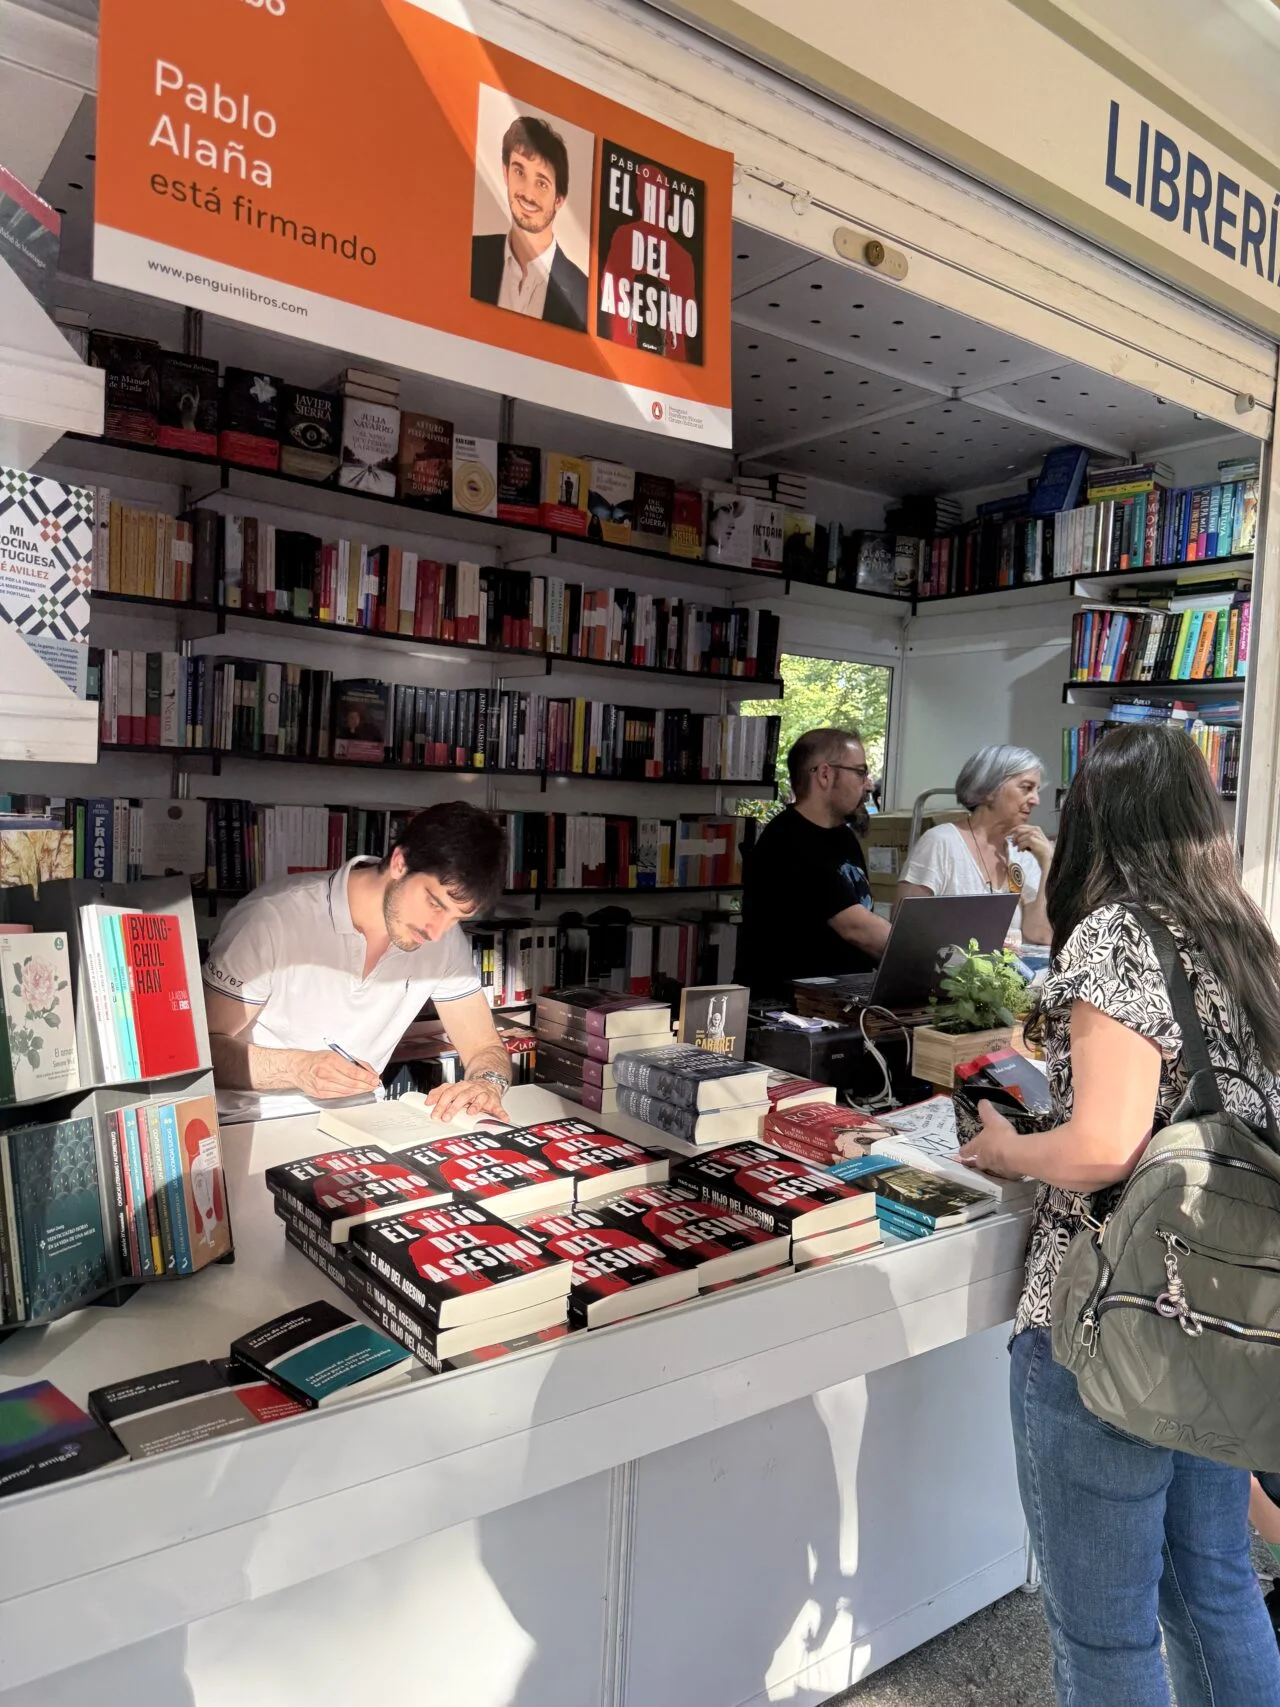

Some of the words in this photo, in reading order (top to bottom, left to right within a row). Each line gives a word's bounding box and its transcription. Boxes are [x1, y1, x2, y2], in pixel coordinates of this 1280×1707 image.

[154, 58, 277, 138] Pablo
[149, 114, 273, 188] Alaña
[611, 153, 650, 178] PABLO
[656, 173, 696, 198] ALAÑA
[609, 167, 633, 217] EL
[643, 181, 695, 239] HIJO
[1105, 99, 1280, 288] LIBRERÍ
[150, 172, 221, 214] está
[232, 195, 377, 266] firmando
[631, 229, 671, 281] DEL
[147, 259, 309, 317] www.penguinlibros.com
[600, 272, 698, 338] ASESINO
[295, 405, 332, 423] SIERRA
[296, 393, 332, 412] JAVIER
[353, 418, 394, 434] NAVARRO
[361, 413, 386, 425] JULIA
[640, 517, 666, 529] GUERRA
[644, 504, 665, 515] AMOR
[0, 534, 39, 553] OCINA
[9, 525, 24, 537] MI
[753, 523, 783, 539] VICTORIA
[0, 547, 56, 569] TUGUESA
[9, 564, 49, 580] AVILLEZ
[93, 816, 105, 878] FRANCO
[130, 917, 172, 942] BYUNG-
[133, 942, 165, 967] CHUL
[136, 968, 163, 995] HAN
[695, 1036, 736, 1052] CABARET
[784, 1105, 841, 1123] ROMA
[514, 1134, 549, 1148] EL
[541, 1123, 596, 1140] HIJO
[554, 1137, 601, 1153] DEL
[412, 1150, 448, 1165] EL
[444, 1137, 502, 1156] HIJO
[454, 1153, 503, 1170] DEL
[556, 1143, 645, 1172] ASESINO
[697, 1162, 737, 1178] EL
[723, 1147, 780, 1167] HIJO
[290, 1165, 326, 1181] EL
[326, 1151, 387, 1171] HIJO
[331, 1167, 383, 1186] DEL
[451, 1159, 550, 1192] ASESINO
[744, 1164, 796, 1183] DEL
[320, 1174, 429, 1209] ASESINO
[608, 1199, 648, 1217] EL
[637, 1187, 699, 1208] HIJO
[756, 1174, 846, 1207] ASESINO
[370, 1214, 414, 1230] PABLO
[422, 1203, 467, 1217] ALAÑA
[654, 1204, 709, 1225] DEL
[702, 1186, 710, 1199] EL
[711, 1189, 728, 1206] HIJO
[729, 1197, 742, 1213] DEL
[744, 1204, 775, 1228] ASESINO
[378, 1223, 420, 1244] EL
[417, 1208, 487, 1233] HIJO
[521, 1228, 548, 1243] L
[540, 1211, 605, 1236] HIJO
[661, 1213, 761, 1250] ASESINO
[317, 1233, 337, 1259] ASESINO
[427, 1230, 488, 1253] DEL
[555, 1233, 613, 1256] DEL
[302, 1240, 309, 1254] EL
[308, 1245, 319, 1263] HIJO
[319, 1254, 327, 1272] DEL
[327, 1262, 346, 1289] ASESINO
[421, 1238, 543, 1284] ASESINO
[571, 1243, 667, 1287] ASESINO
[370, 1252, 377, 1268] EL
[377, 1257, 391, 1278] HIJO
[390, 1268, 401, 1288] DEL
[401, 1277, 426, 1308] ASESINO
[366, 1281, 374, 1297] EL
[373, 1287, 387, 1308] HIJO
[387, 1298, 398, 1318] DEL
[398, 1309, 422, 1340] ASESINO
[382, 1312, 389, 1329] EL
[390, 1317, 404, 1341] HIJO
[404, 1331, 415, 1352] DEL
[416, 1342, 443, 1374] ASESINO
[38, 1450, 78, 1469] amigas
